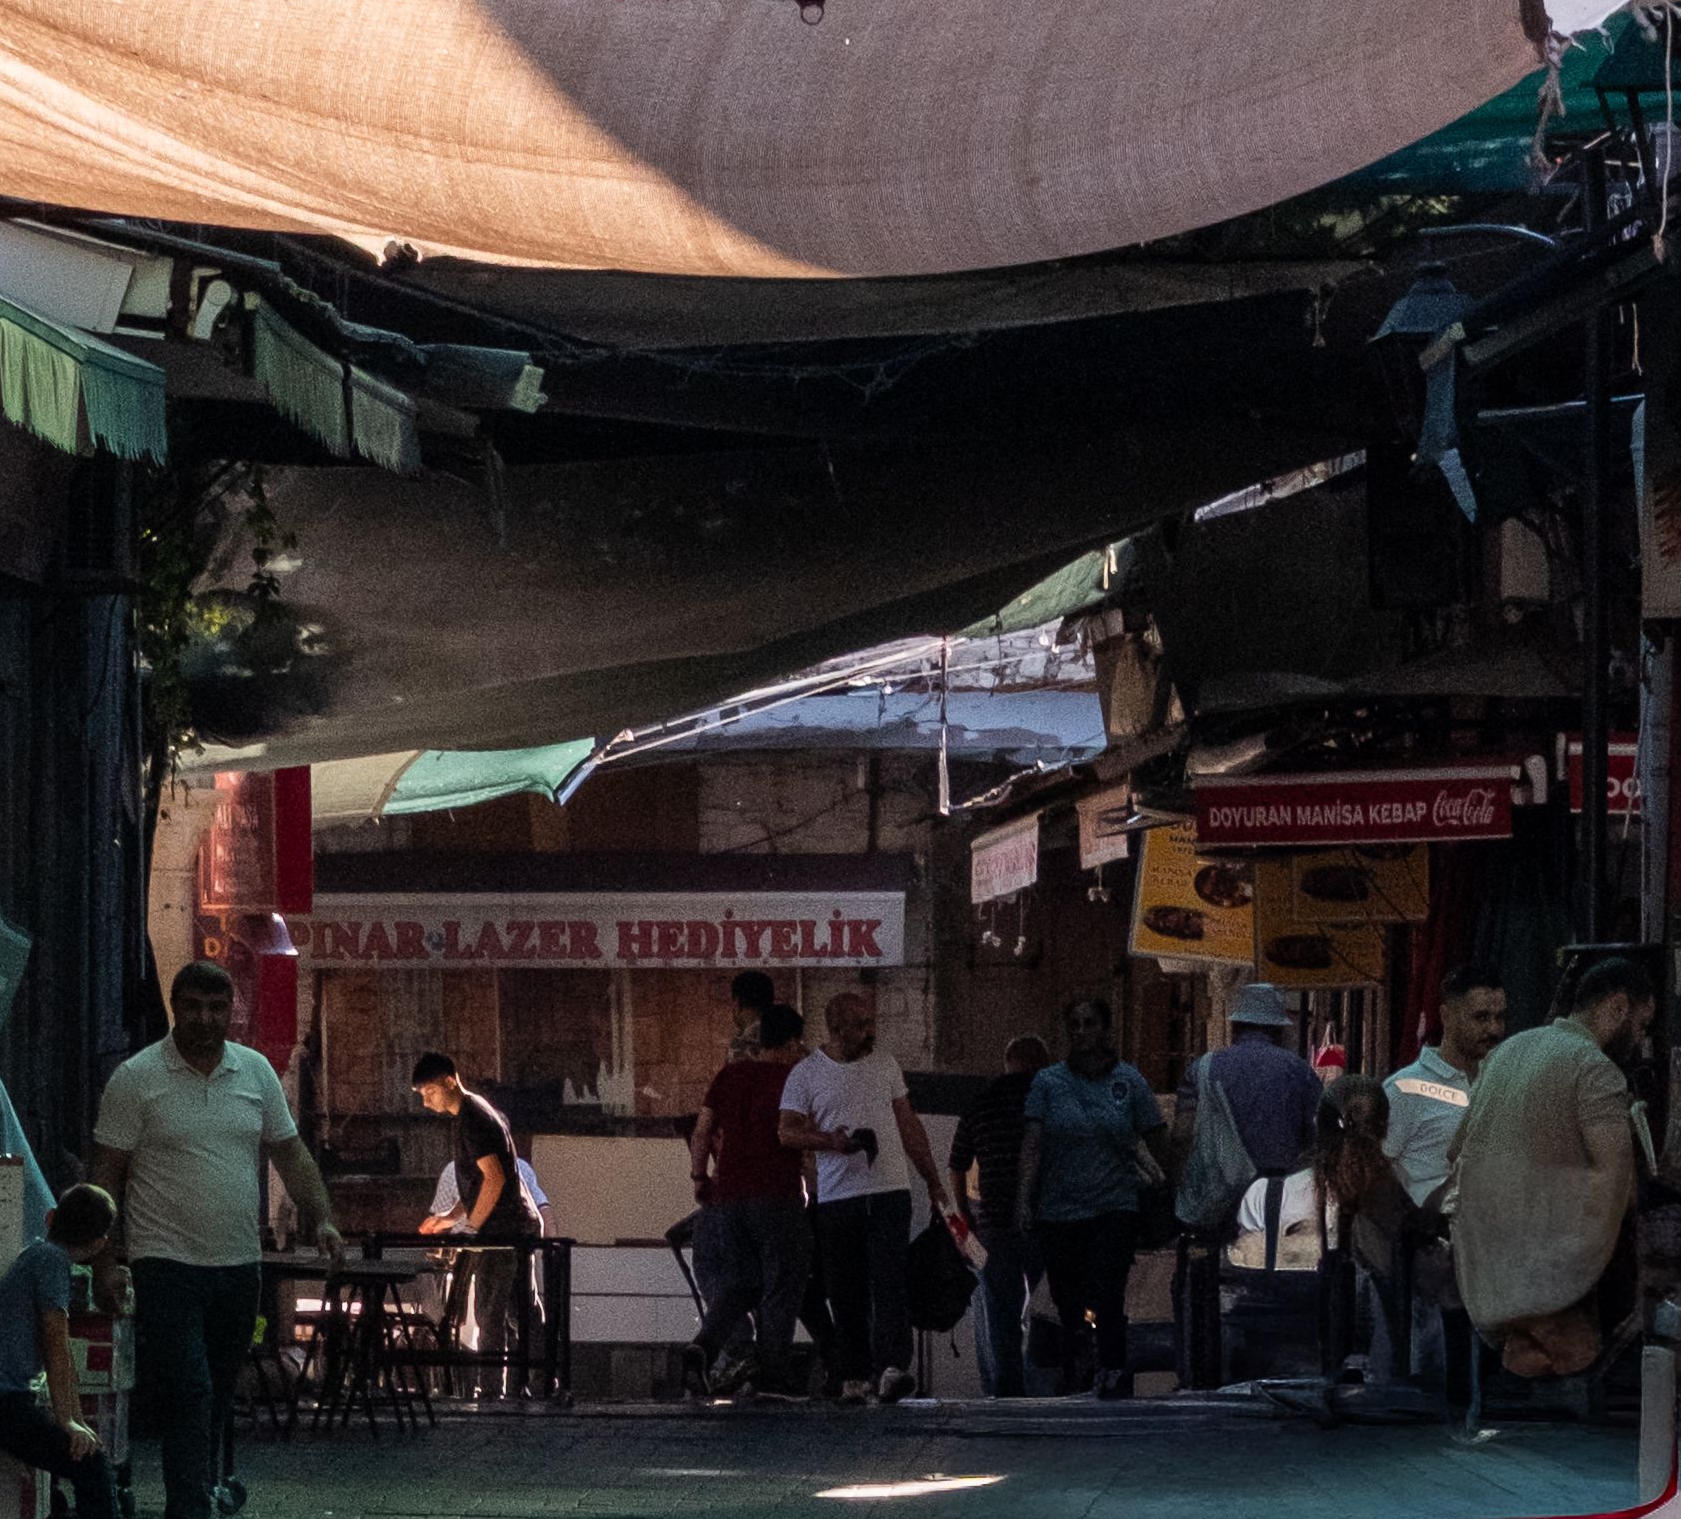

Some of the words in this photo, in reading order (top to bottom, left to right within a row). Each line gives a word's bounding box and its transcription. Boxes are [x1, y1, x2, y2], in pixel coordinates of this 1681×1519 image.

[1209, 805, 1292, 828] DOYURAN
[1296, 798, 1364, 827] MANİSA
[1369, 801, 1427, 824] KEBAP
[444, 919, 604, 961] LAZER
[616, 908, 883, 960] HEDİYELİK
